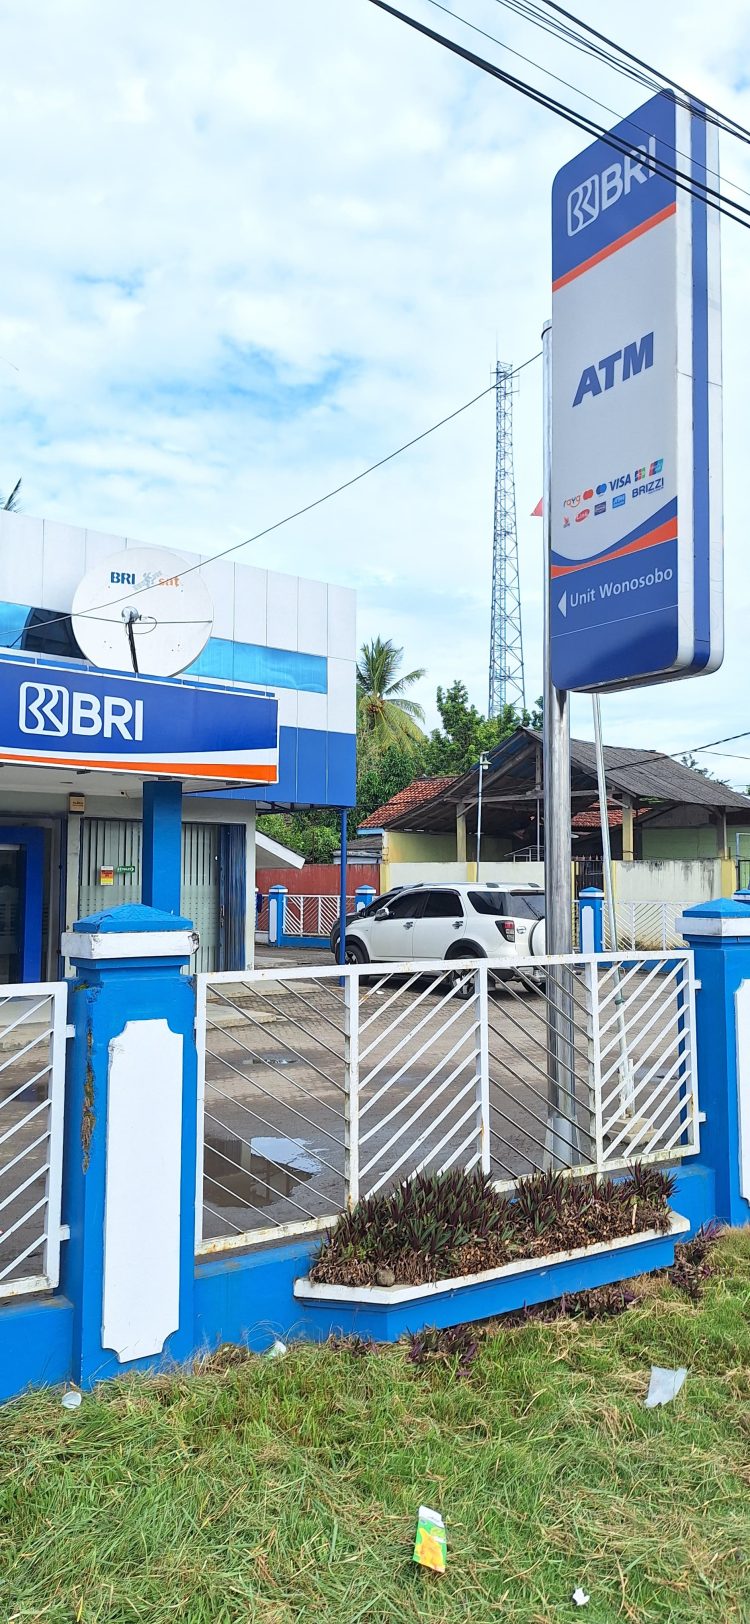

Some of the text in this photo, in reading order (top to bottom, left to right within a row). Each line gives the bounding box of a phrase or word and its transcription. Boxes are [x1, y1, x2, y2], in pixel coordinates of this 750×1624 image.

[601, 134, 656, 212] BRI
[572, 331, 654, 408] ATM
[608, 473, 632, 491] VISA
[632, 477, 664, 498] BRIZZI
[110, 571, 136, 585] BRI
[570, 567, 673, 607] Unit Wonosobo
[72, 691, 144, 741] BRI
